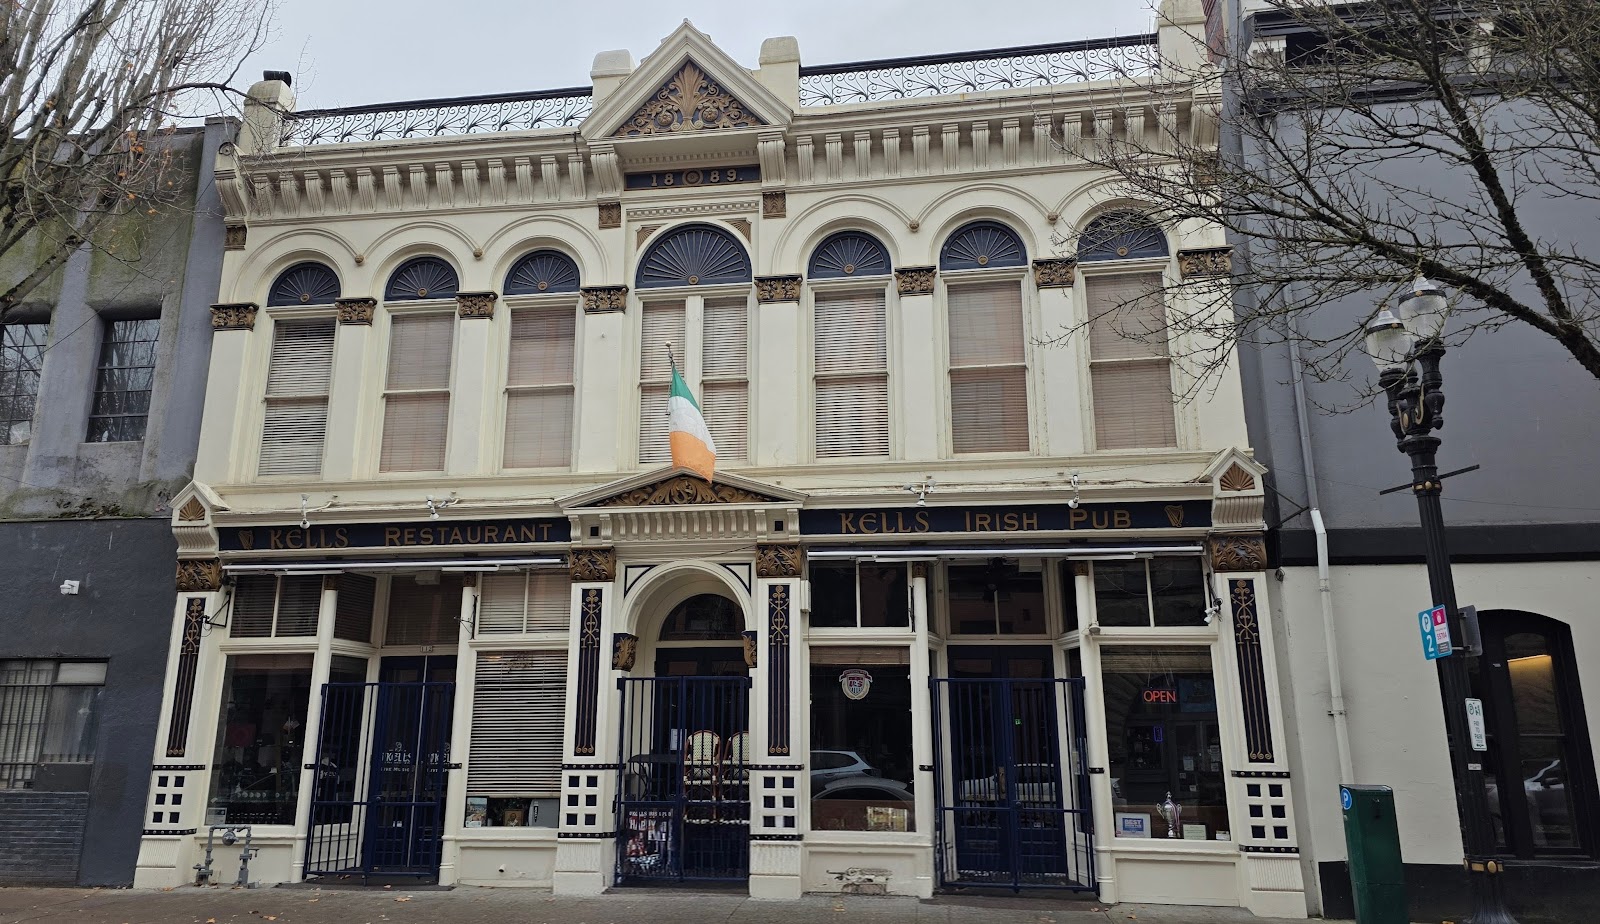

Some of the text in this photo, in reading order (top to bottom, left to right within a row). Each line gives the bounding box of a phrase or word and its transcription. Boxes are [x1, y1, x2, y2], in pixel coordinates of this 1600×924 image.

[839, 508, 1132, 534] KELLS IRISH PUB
[269, 523, 553, 550] KELLS RESTAURANT
[1426, 634, 1434, 652] 2
[1143, 690, 1176, 703] OPEN
